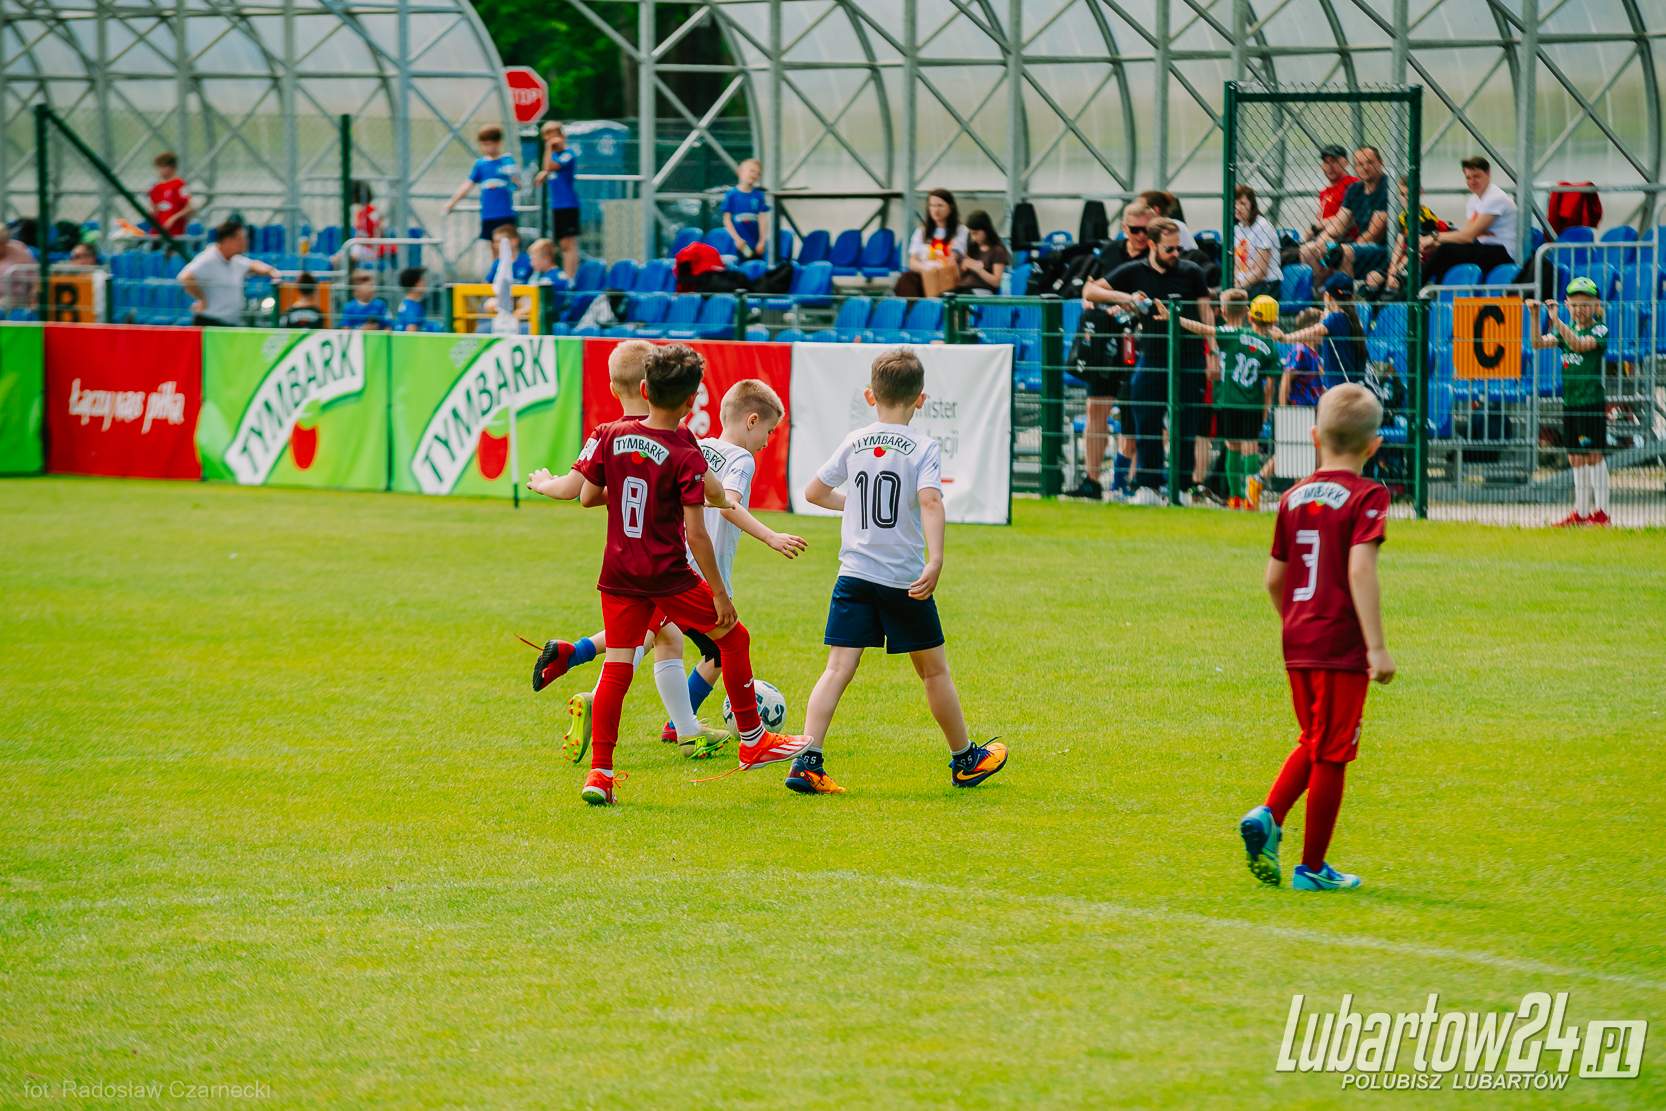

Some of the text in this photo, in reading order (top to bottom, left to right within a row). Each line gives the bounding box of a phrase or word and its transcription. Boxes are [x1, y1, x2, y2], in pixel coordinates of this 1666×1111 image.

[1473, 305, 1506, 369] C
[239, 333, 357, 475] TYMBARK
[422, 338, 550, 484] TYMBARK
[615, 437, 665, 462] TYMBARK
[621, 475, 648, 539] 8
[854, 470, 902, 530] 10
[1292, 529, 1321, 602] 3
